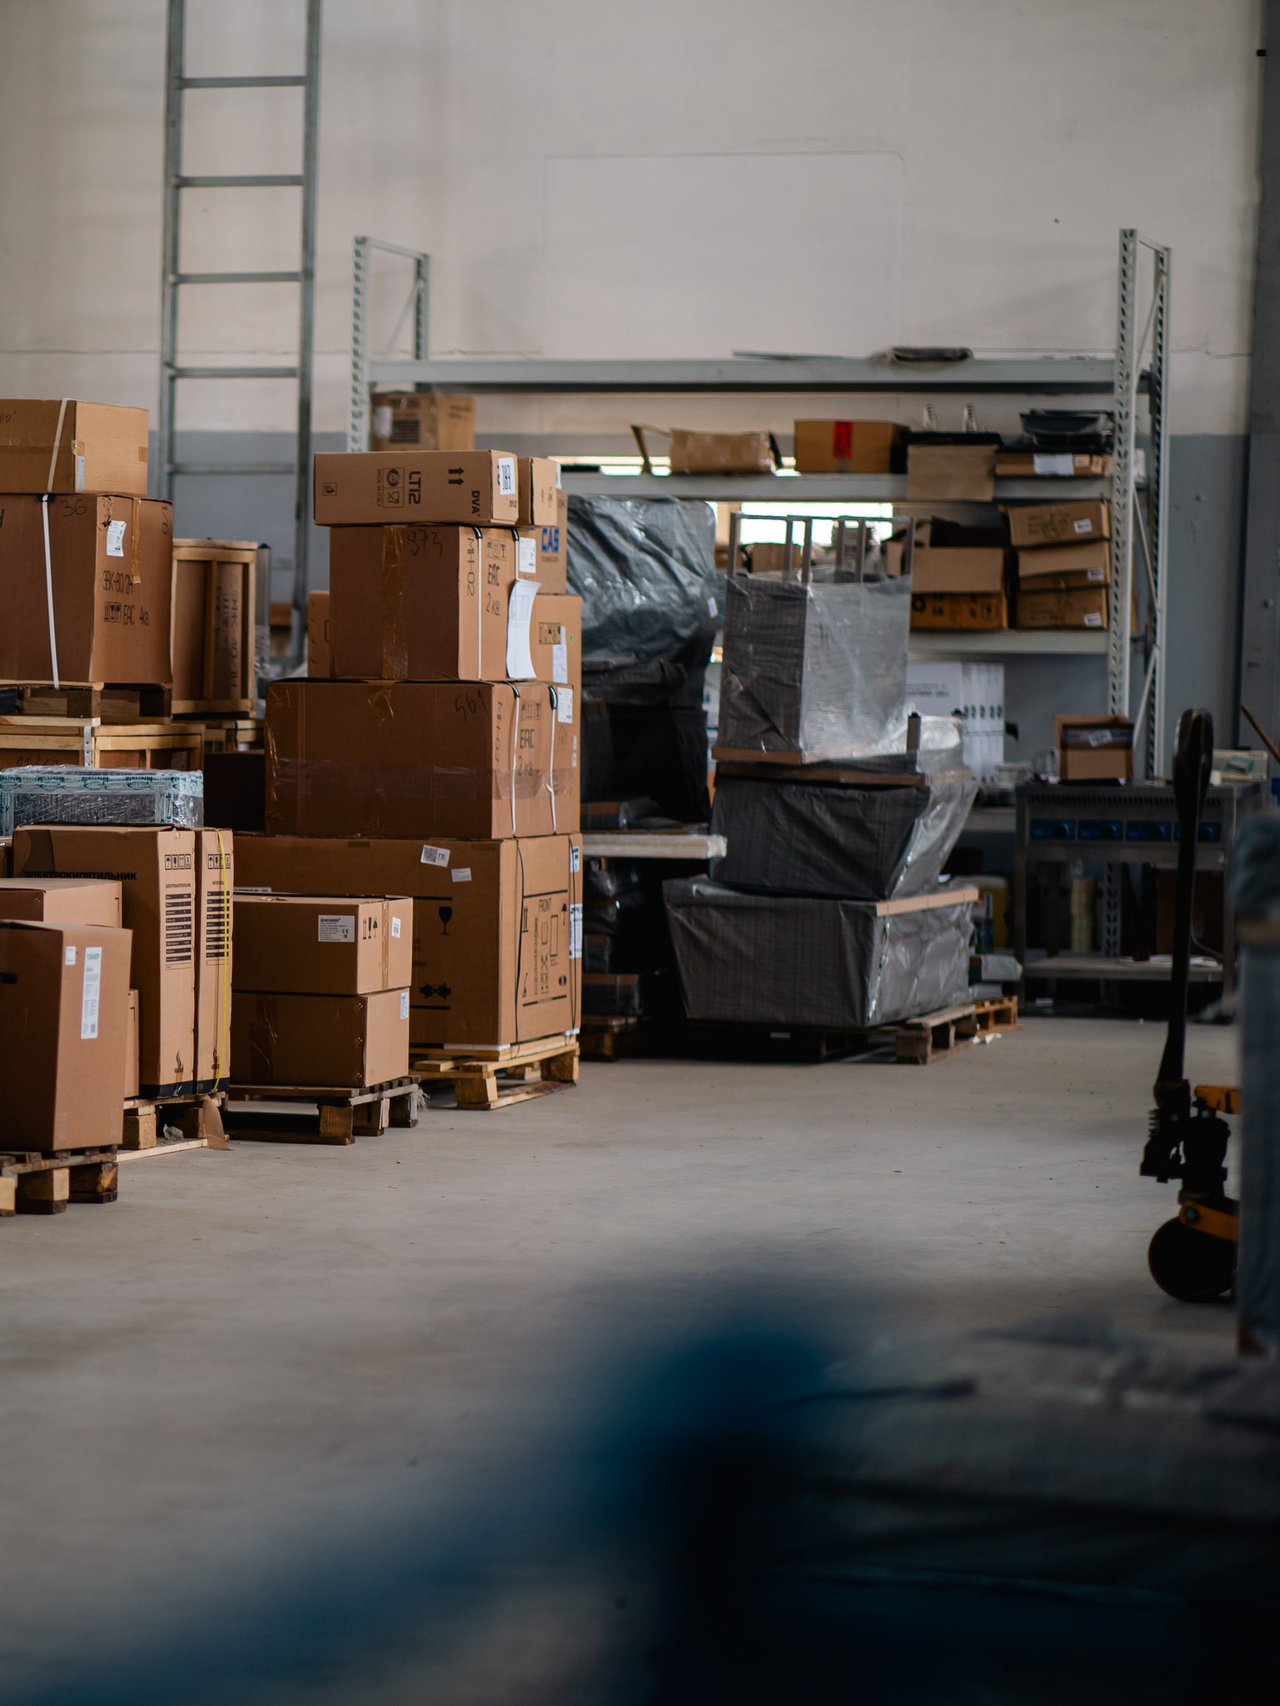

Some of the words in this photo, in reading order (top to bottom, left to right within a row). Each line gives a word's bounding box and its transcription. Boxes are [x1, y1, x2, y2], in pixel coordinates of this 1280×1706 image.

[61, 500, 88, 516] 36
[471, 490, 481, 514] DVA
[541, 527, 560, 553] CAS
